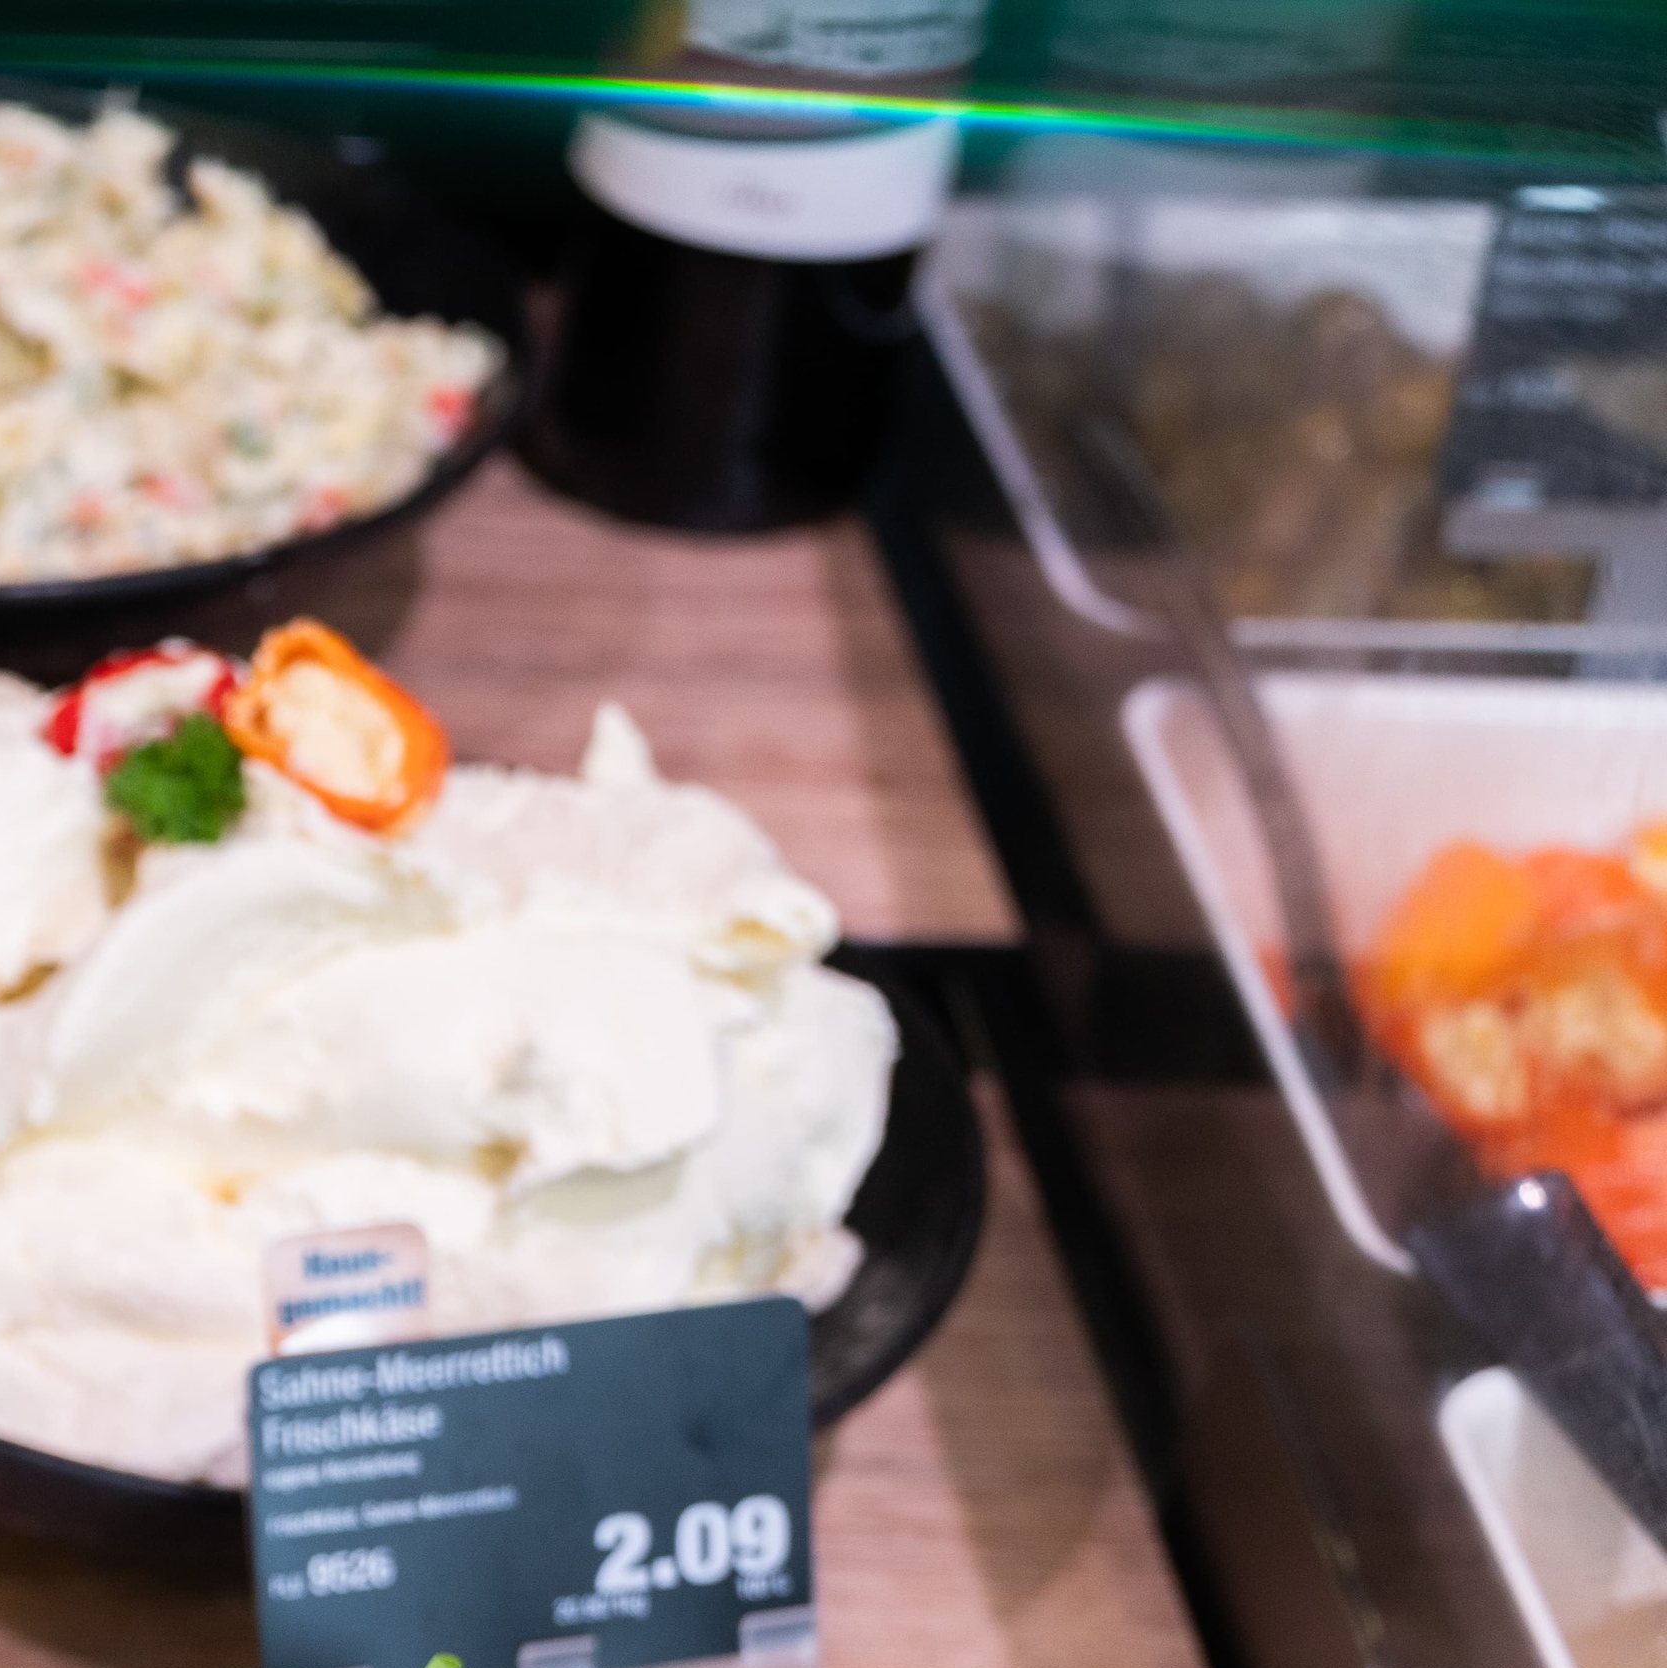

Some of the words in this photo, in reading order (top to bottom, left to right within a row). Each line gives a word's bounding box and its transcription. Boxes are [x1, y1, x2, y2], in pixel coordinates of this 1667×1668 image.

[259, 1334, 569, 1411] Sahne-Meerrettich
[262, 1402, 444, 1456] Frischkäse
[595, 1494, 792, 1593] 2.09
